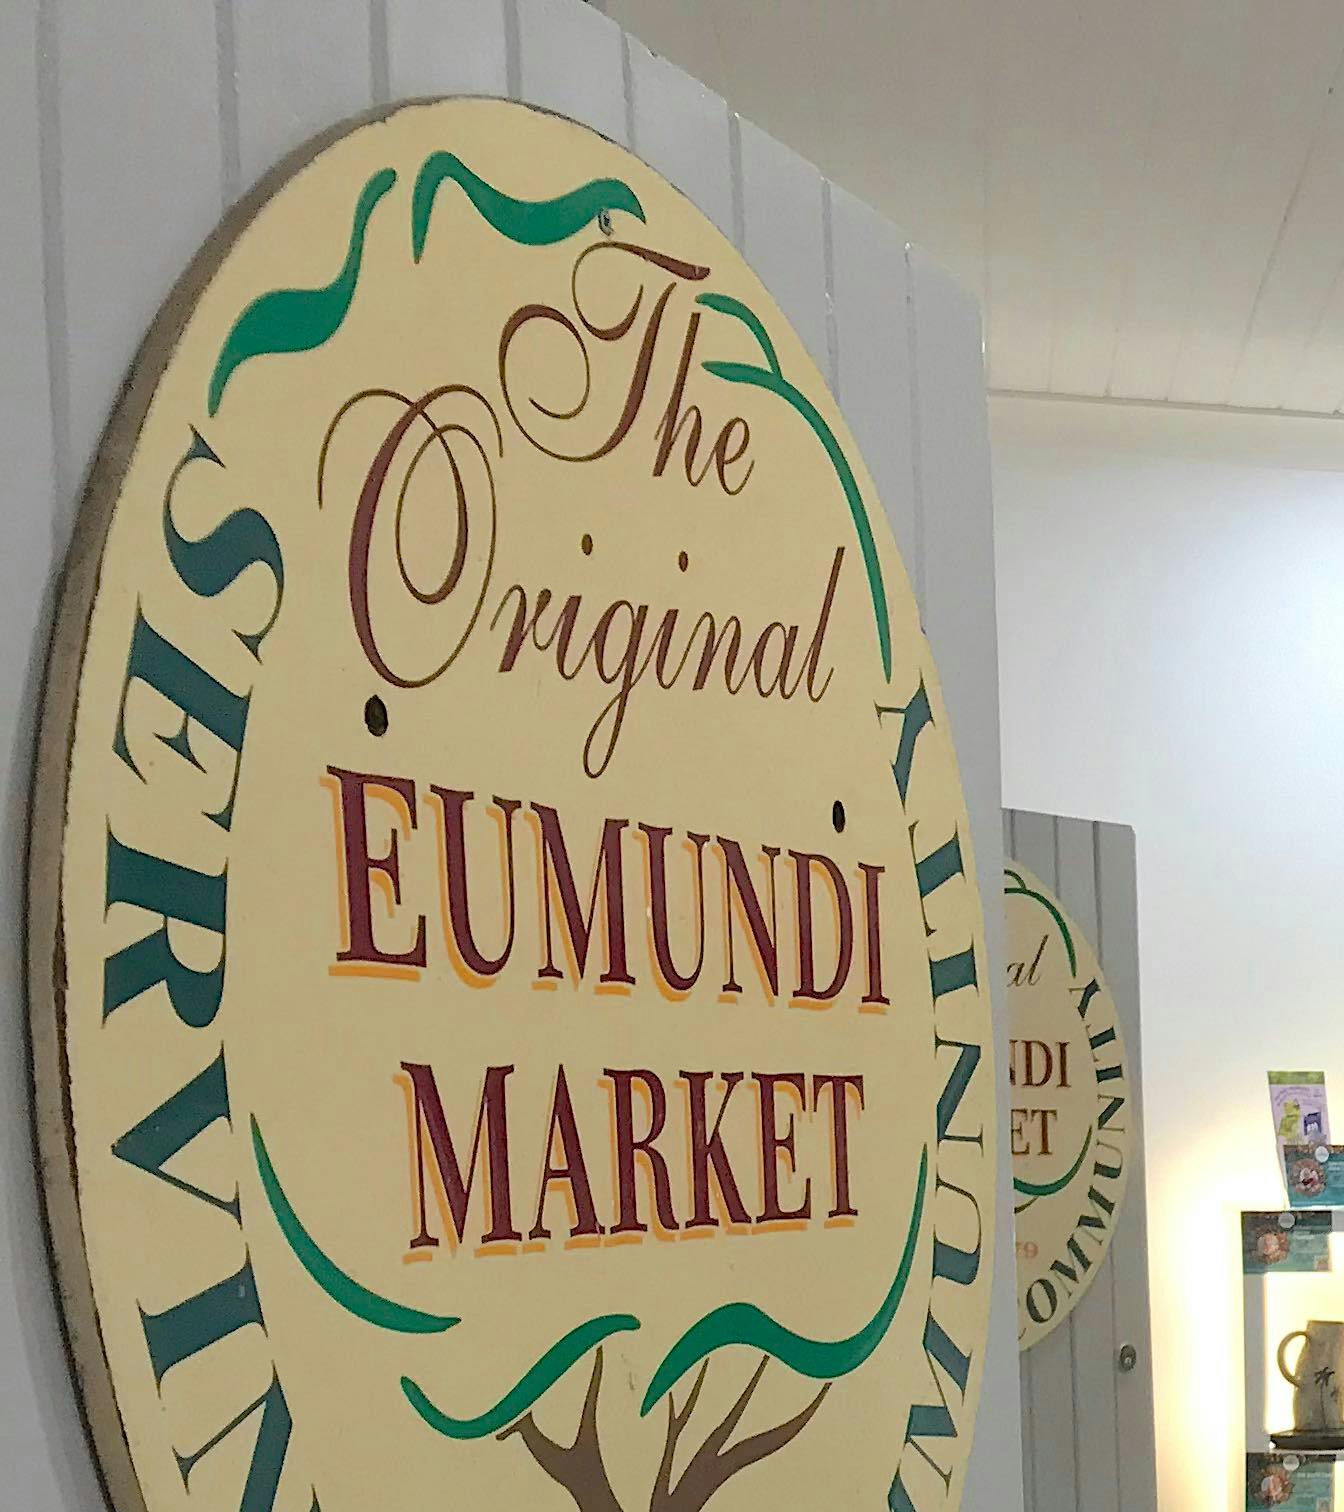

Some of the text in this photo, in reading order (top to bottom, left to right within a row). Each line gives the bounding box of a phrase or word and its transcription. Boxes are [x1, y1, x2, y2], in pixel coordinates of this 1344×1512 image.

[499, 241, 753, 496] The
[318, 383, 846, 778] Original
[321, 764, 891, 1008] EUMUNDI
[396, 1062, 865, 1258] MARKET
[1018, 977, 1125, 1340] OMMUNITY
